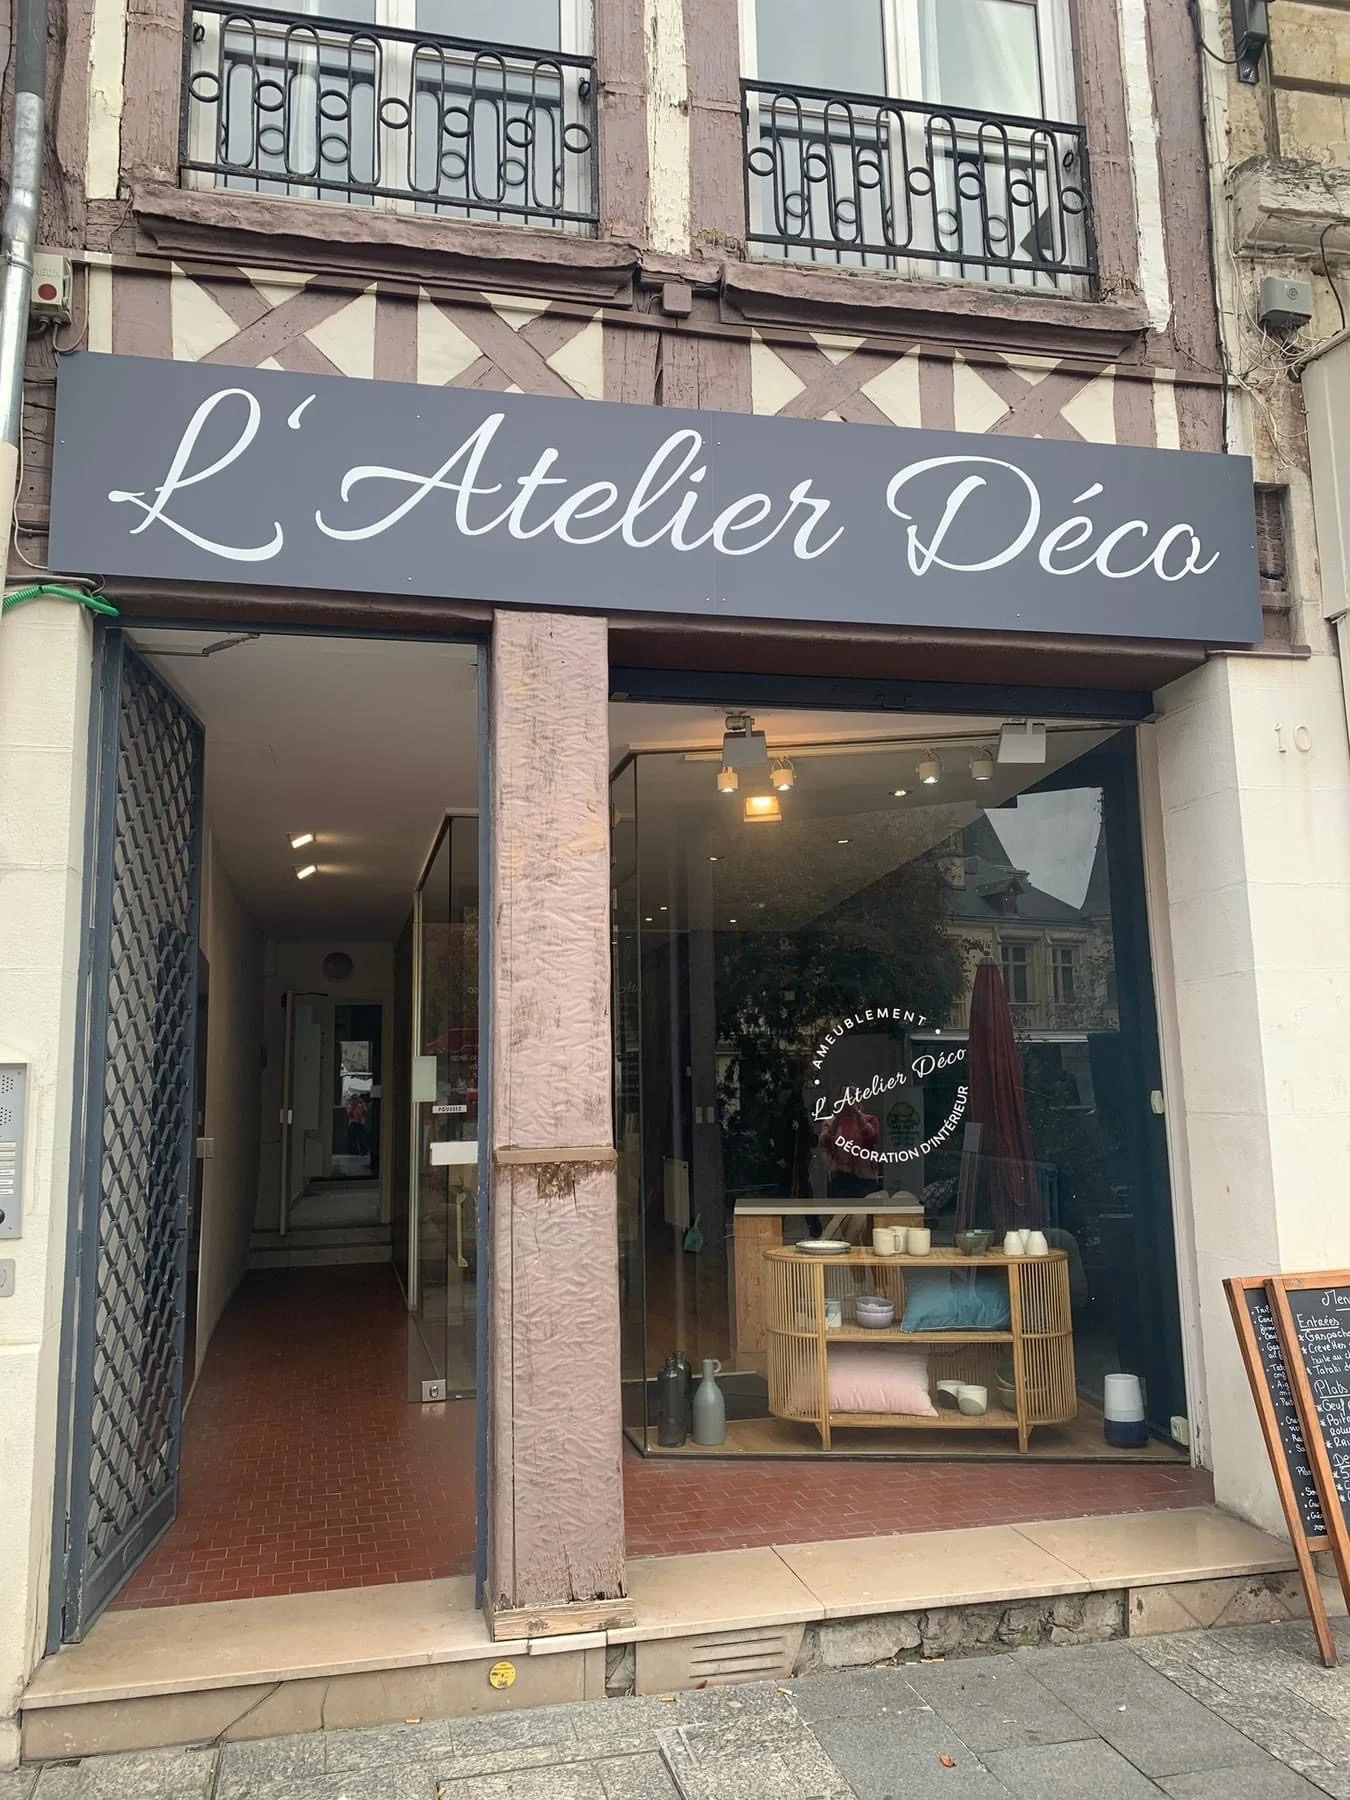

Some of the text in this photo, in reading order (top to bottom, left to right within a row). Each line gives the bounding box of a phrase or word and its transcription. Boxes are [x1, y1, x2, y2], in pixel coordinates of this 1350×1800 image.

[886, 455, 1220, 581] Déco
[1274, 723, 1312, 753] 10
[812, 1007, 927, 1069] AMEUBLEMENT
[811, 1048, 968, 1122] L'Atelier Déco
[834, 1085, 969, 1163] DÉCORATION D'INTÉRIEUR
[1313, 1379, 1349, 1396] Plats
